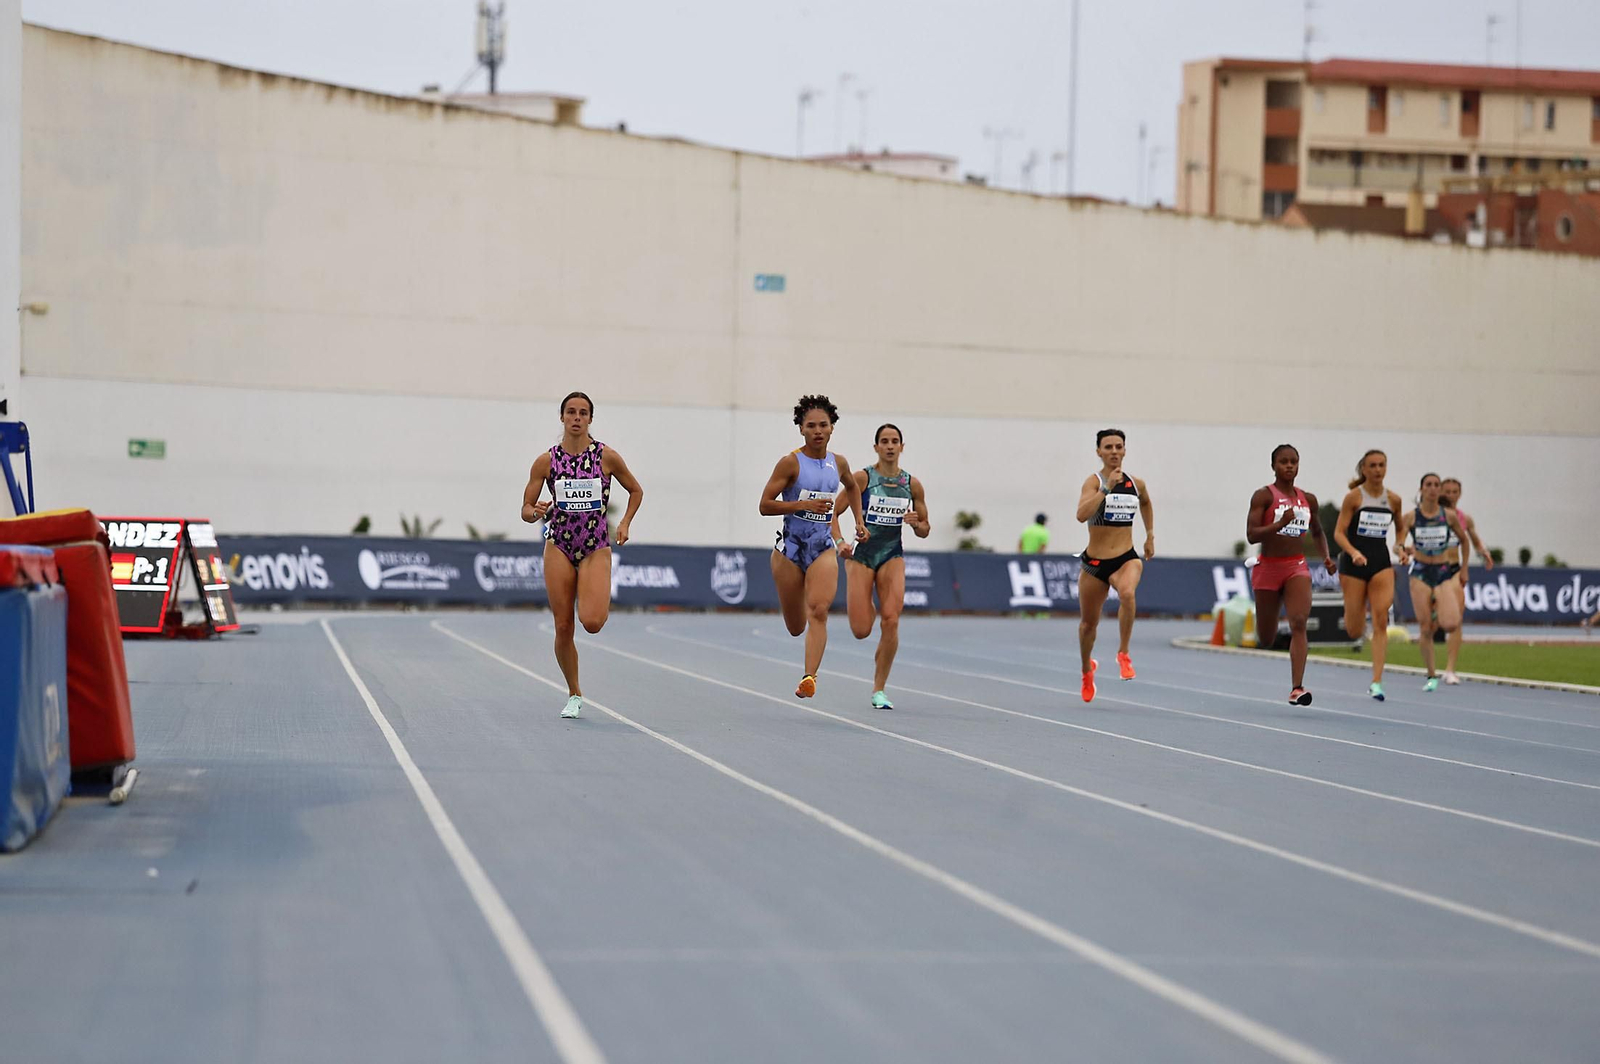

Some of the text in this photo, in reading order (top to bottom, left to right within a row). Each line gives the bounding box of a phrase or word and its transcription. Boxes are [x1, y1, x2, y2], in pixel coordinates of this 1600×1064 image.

[565, 490, 593, 499] LAUS
[565, 502, 593, 510] Joma
[869, 505, 906, 515] AZEVEDO
[803, 512, 827, 521] Joma
[874, 516, 898, 524] Joma
[99, 522, 181, 548] NDEZ
[1556, 573, 1600, 614] ele
